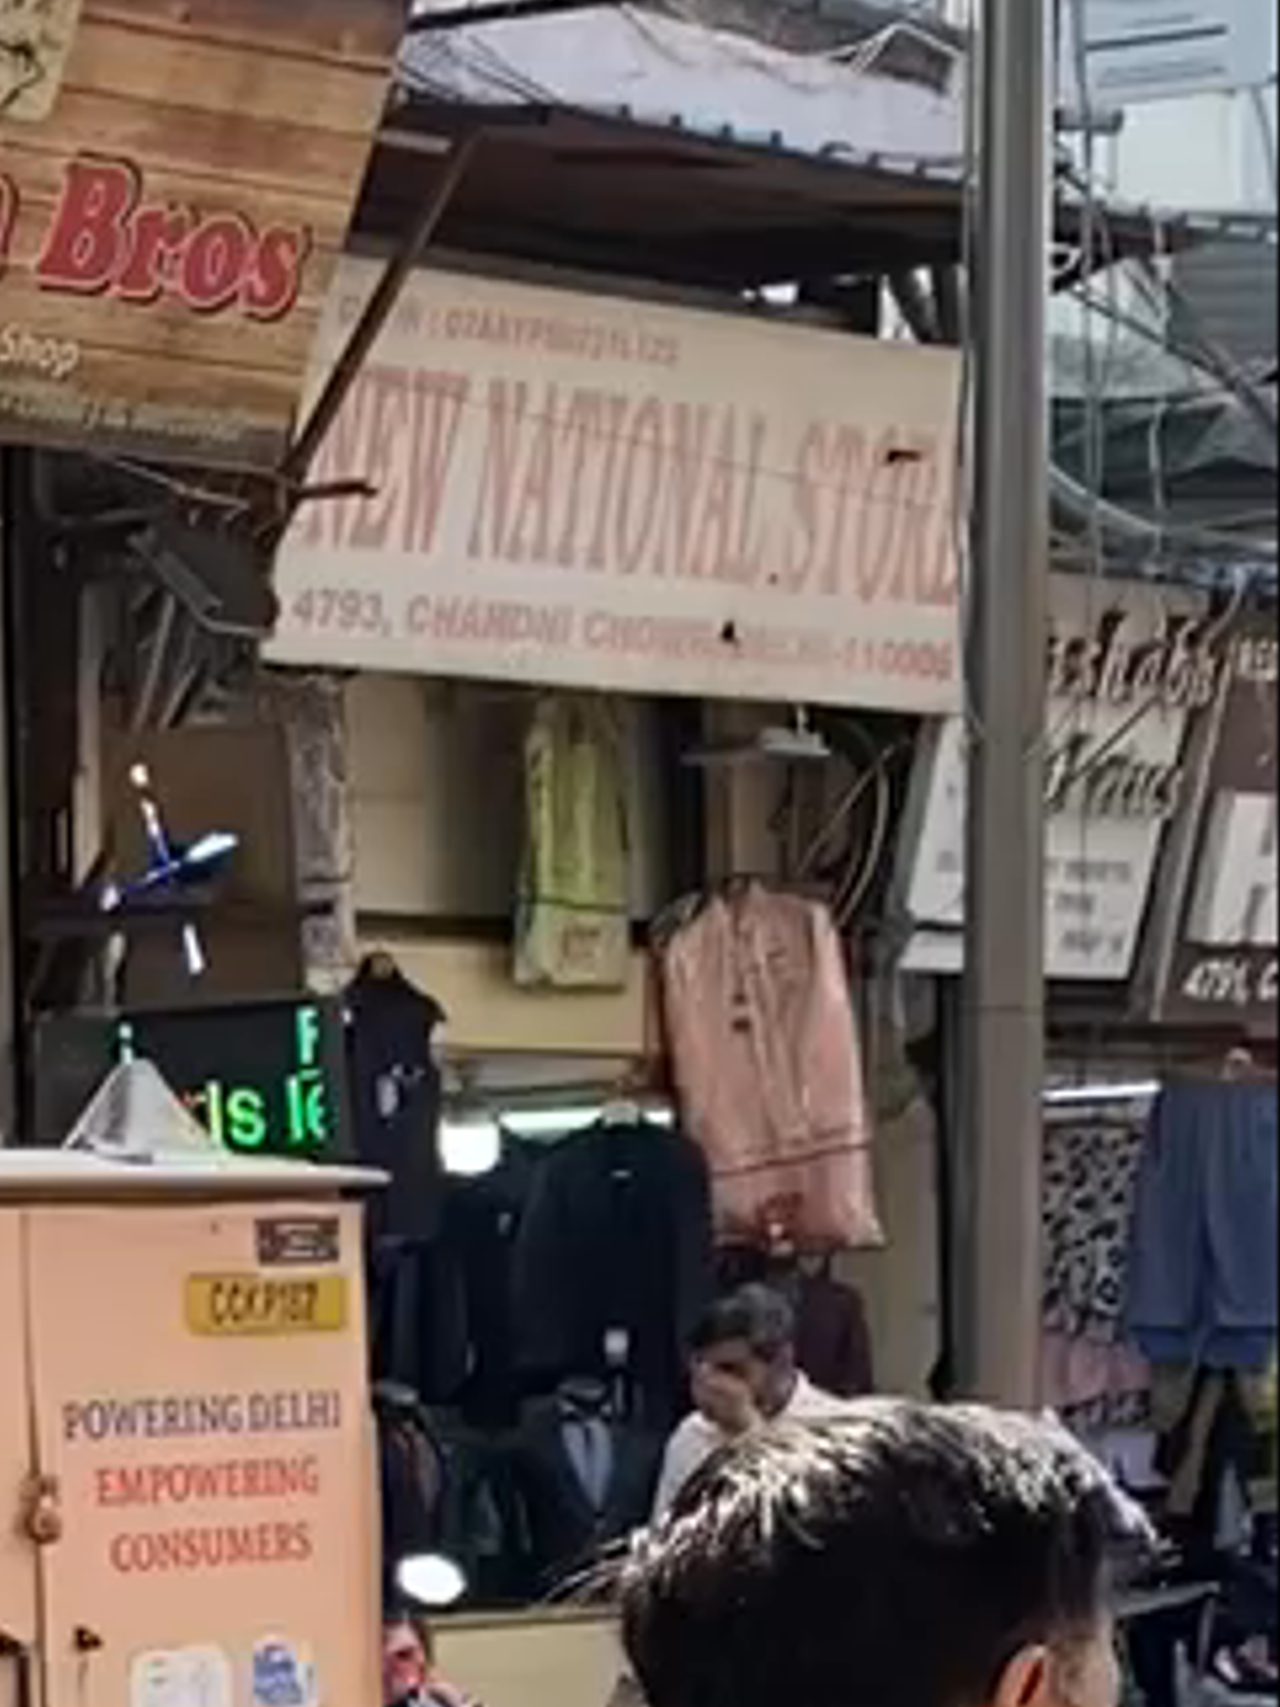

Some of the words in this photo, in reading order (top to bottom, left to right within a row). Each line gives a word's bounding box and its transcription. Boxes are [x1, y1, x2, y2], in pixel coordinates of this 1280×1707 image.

[38, 151, 307, 323] Bros
[308, 367, 469, 553] NEW
[467, 379, 764, 587] NATIONAL
[791, 419, 957, 606] STOR
[62, 1395, 243, 1440] POWERING
[248, 1389, 341, 1433] DELHI
[95, 1457, 320, 1508] EMPOWERING
[109, 1522, 314, 1574] CONSUMERS
